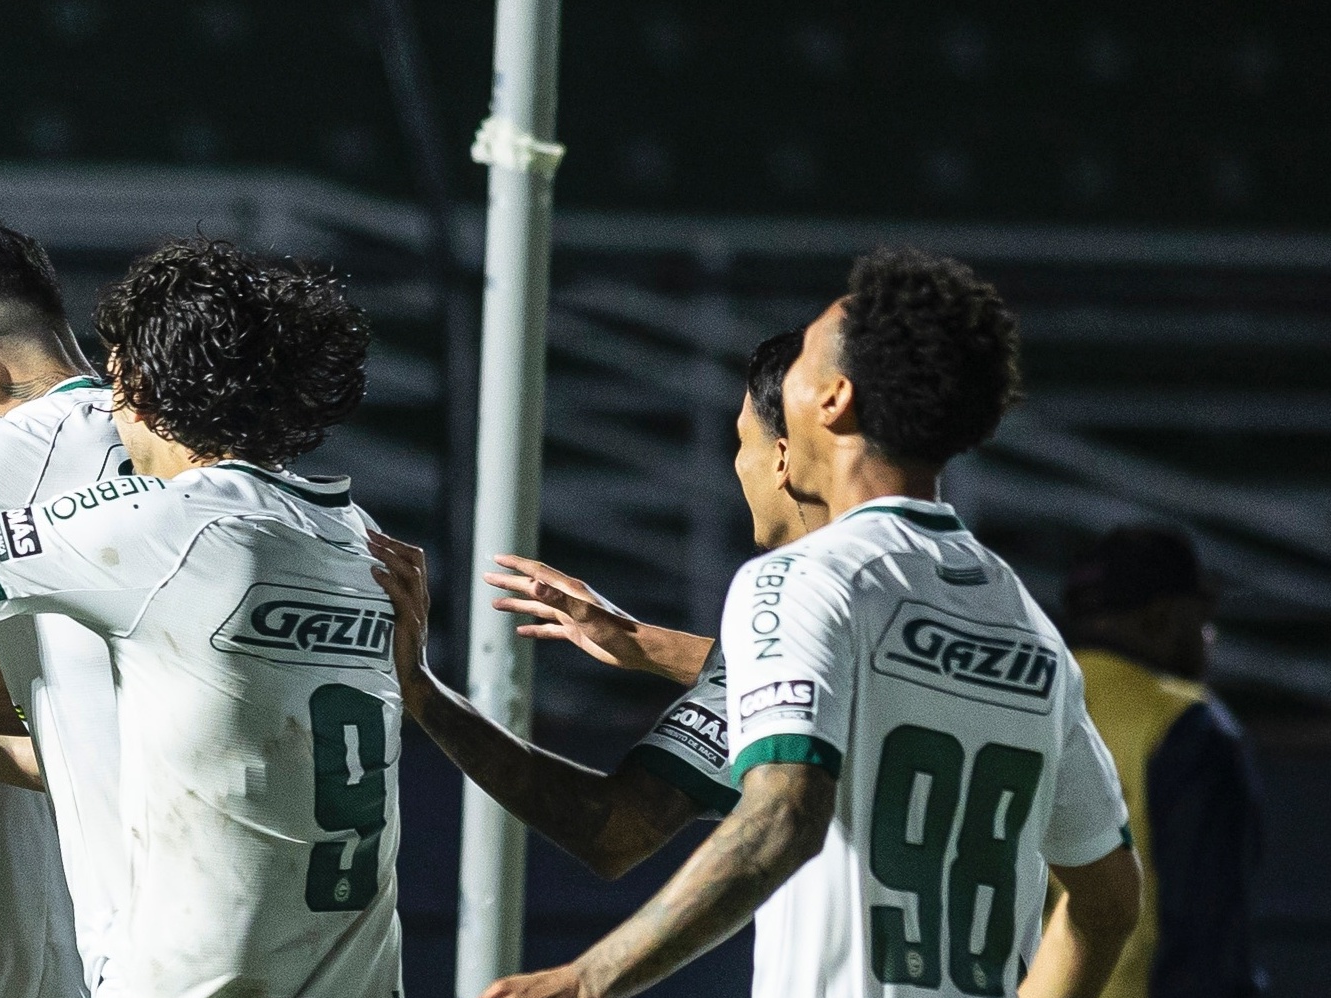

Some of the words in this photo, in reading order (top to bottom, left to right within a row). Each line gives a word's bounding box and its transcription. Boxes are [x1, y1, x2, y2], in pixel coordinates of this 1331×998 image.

[42, 476, 166, 526] HEBRO
[305, 683, 390, 913] 9
[870, 723, 1045, 998] 98
